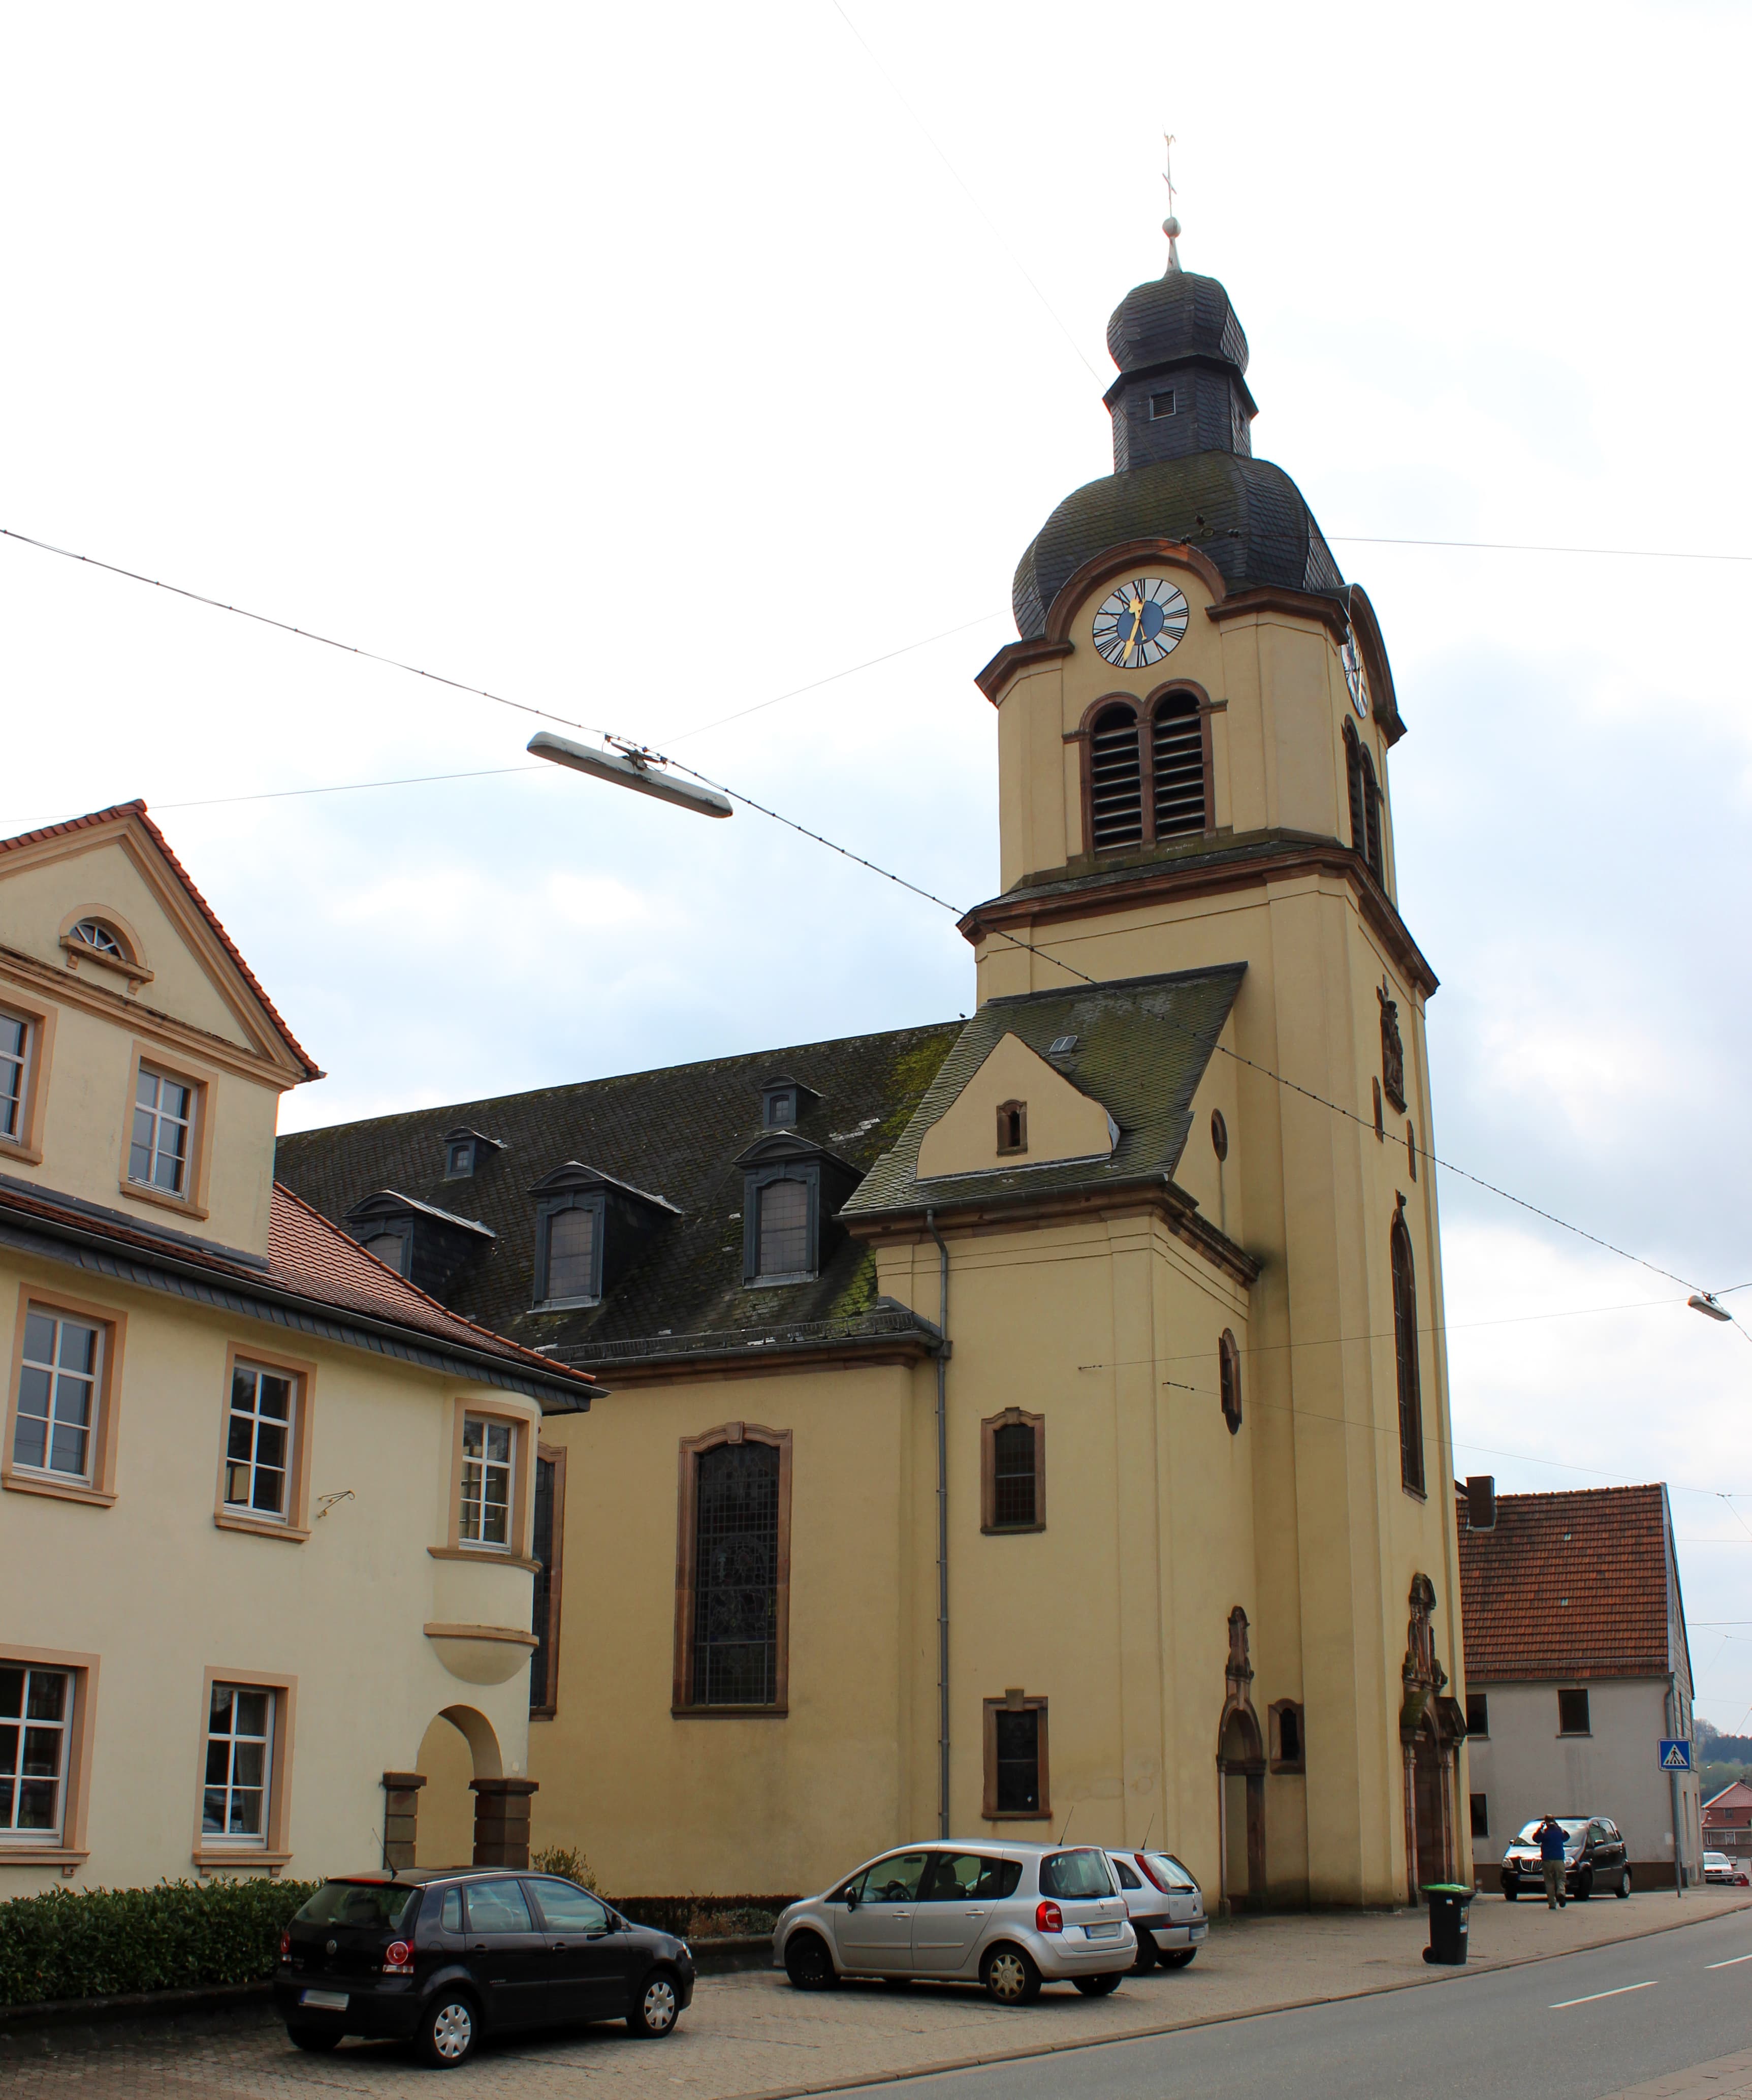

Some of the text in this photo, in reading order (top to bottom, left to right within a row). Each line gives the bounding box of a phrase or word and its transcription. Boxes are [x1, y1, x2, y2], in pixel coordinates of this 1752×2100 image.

[1111, 588, 1131, 610] XI
[1132, 579, 1146, 603] XII
[1151, 580, 1163, 602] I
[1159, 589, 1182, 609] II
[1097, 607, 1121, 620] X
[1164, 607, 1188, 619] III
[1093, 624, 1117, 637] IX
[1160, 626, 1185, 641] IIII
[1096, 635, 1122, 660] VIII
[1136, 644, 1148, 667] VI
[1153, 639, 1169, 658] V
